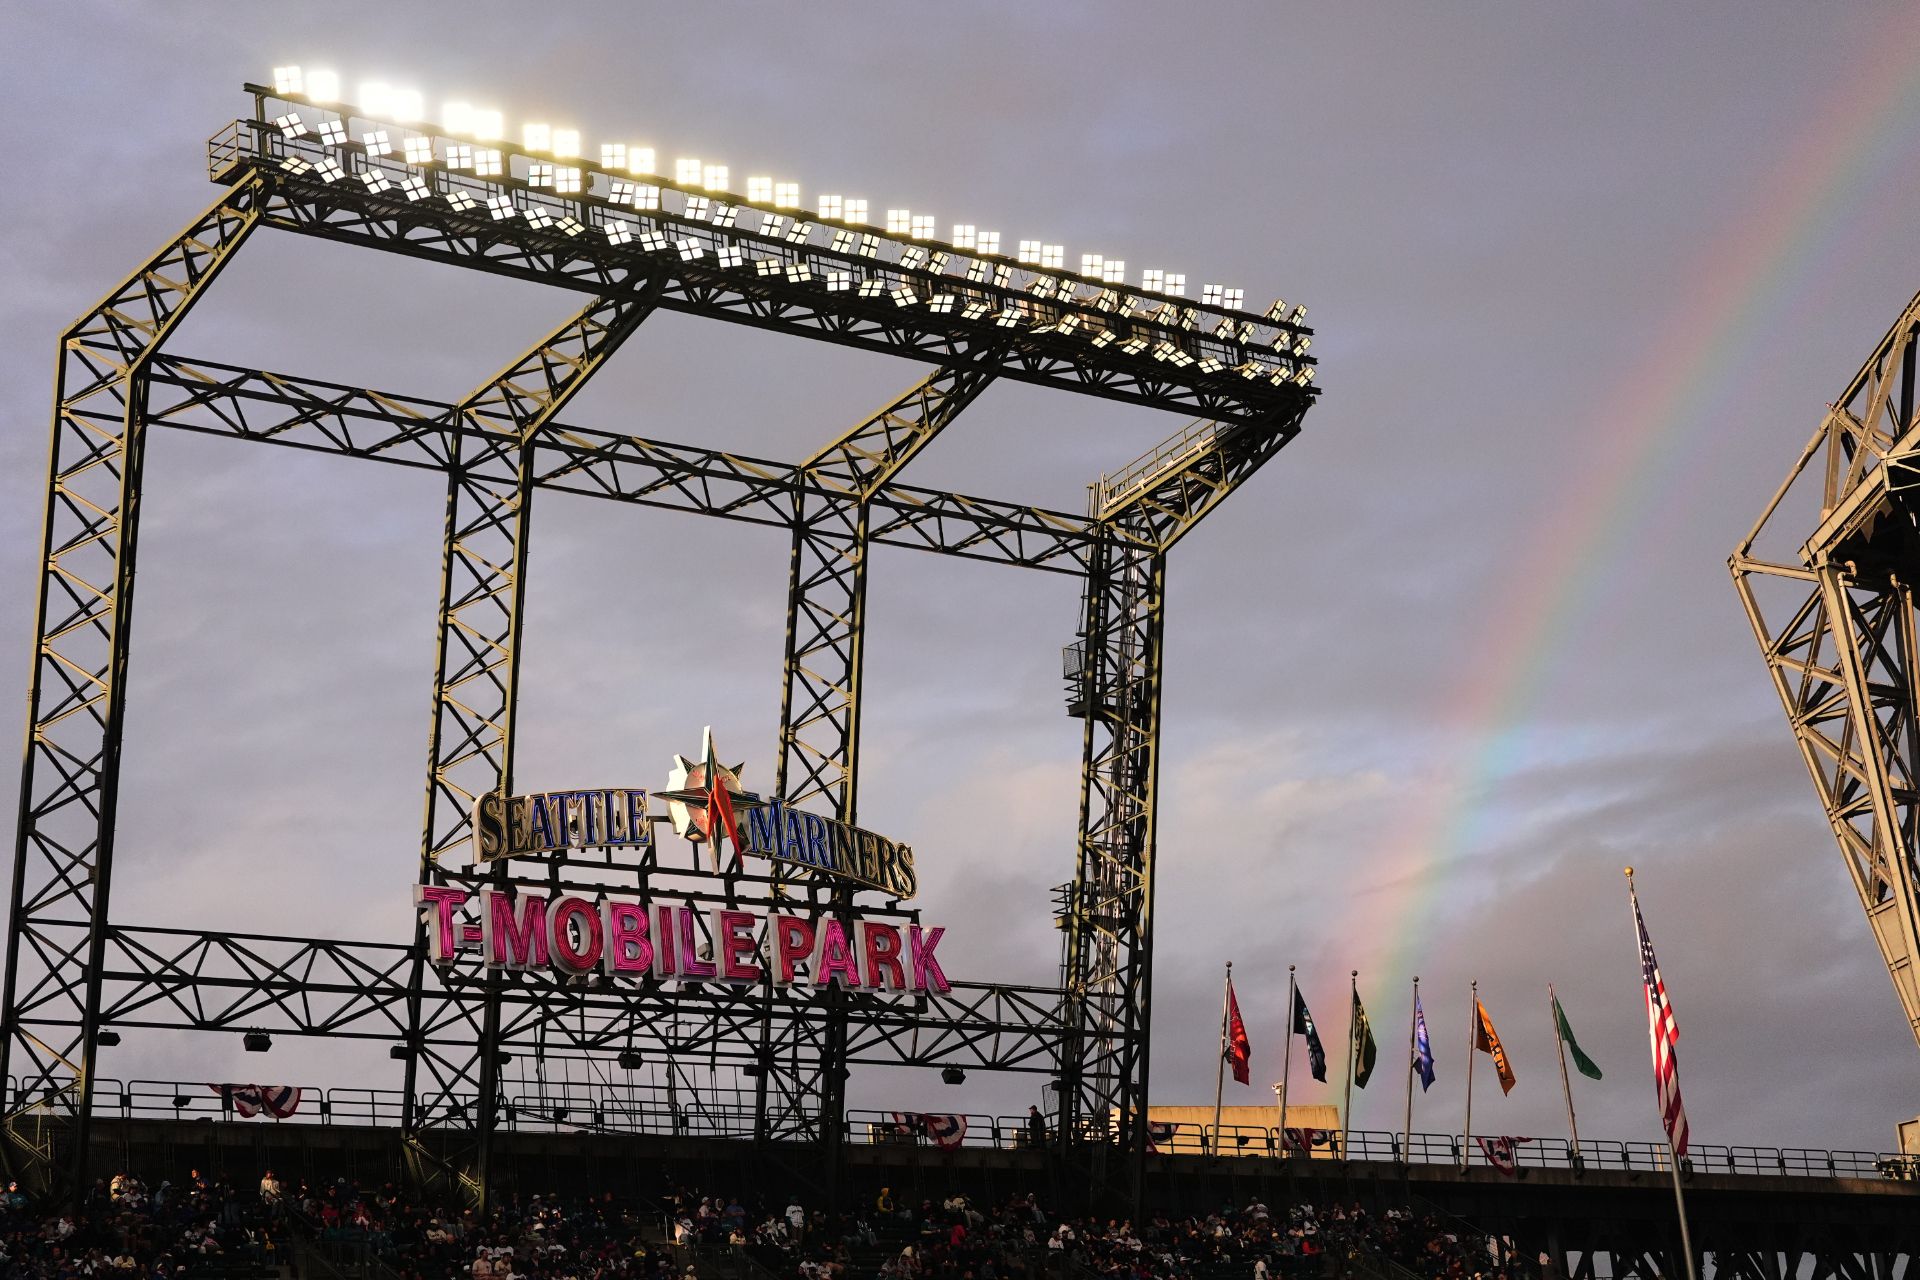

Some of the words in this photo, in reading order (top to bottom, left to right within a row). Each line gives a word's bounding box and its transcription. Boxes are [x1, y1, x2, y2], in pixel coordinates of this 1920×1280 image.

[474, 789, 652, 862] SEATTLE
[743, 793, 917, 899] MARINERS
[414, 884, 761, 982] T-MOBILE
[768, 913, 952, 996] PARK
